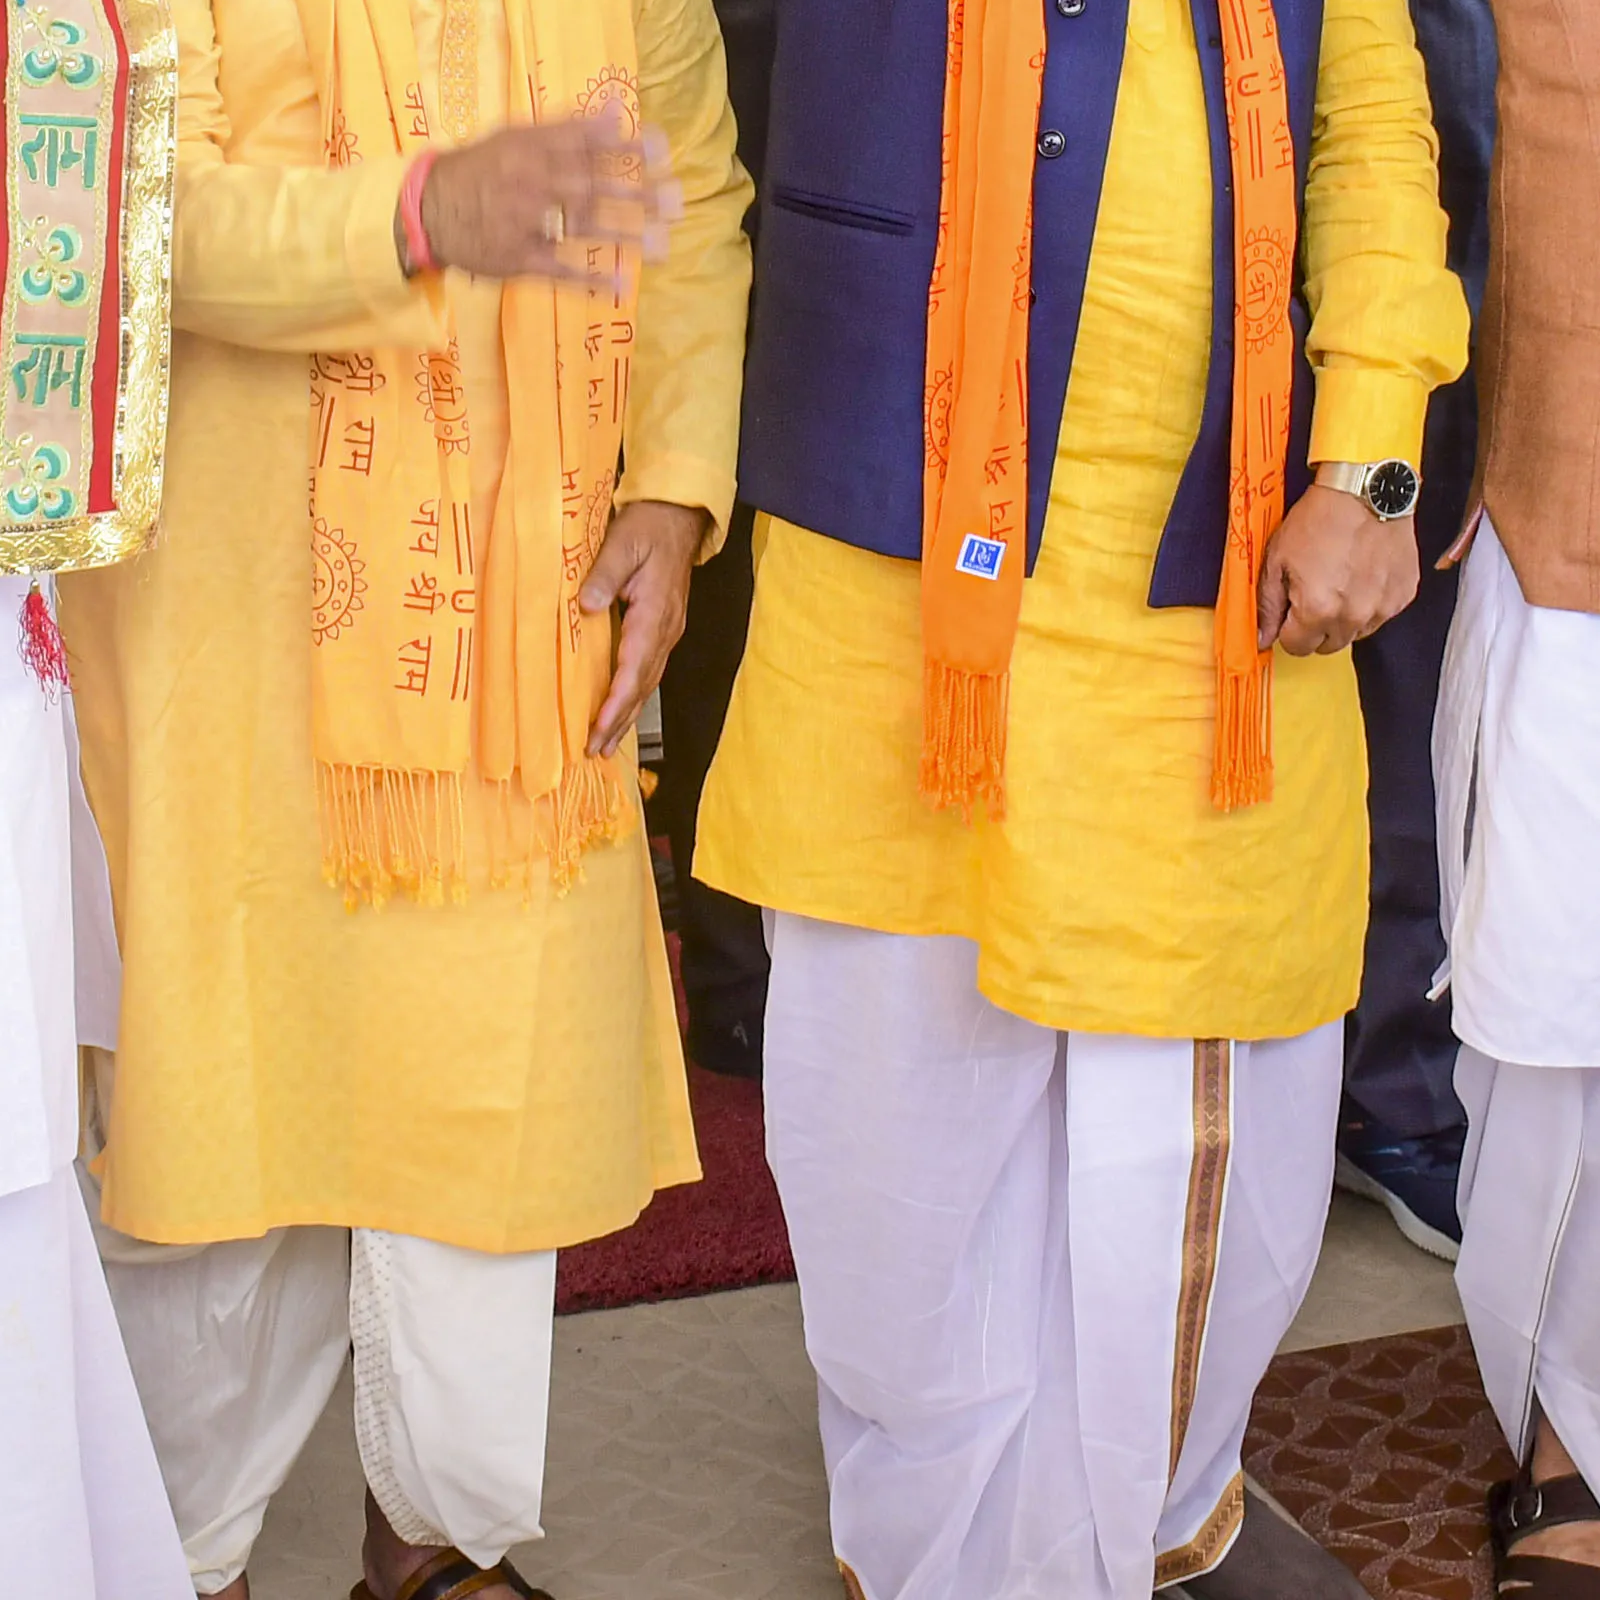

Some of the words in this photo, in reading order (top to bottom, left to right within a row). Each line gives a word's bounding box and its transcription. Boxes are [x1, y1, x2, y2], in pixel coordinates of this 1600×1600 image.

[405, 81, 430, 140] जय
[18, 114, 98, 190] राम
[13, 333, 87, 408] राम
[340, 415, 375, 477] राम
[408, 498, 441, 558] जय
[403, 571, 446, 615] श्री
[394, 635, 432, 697] राम
